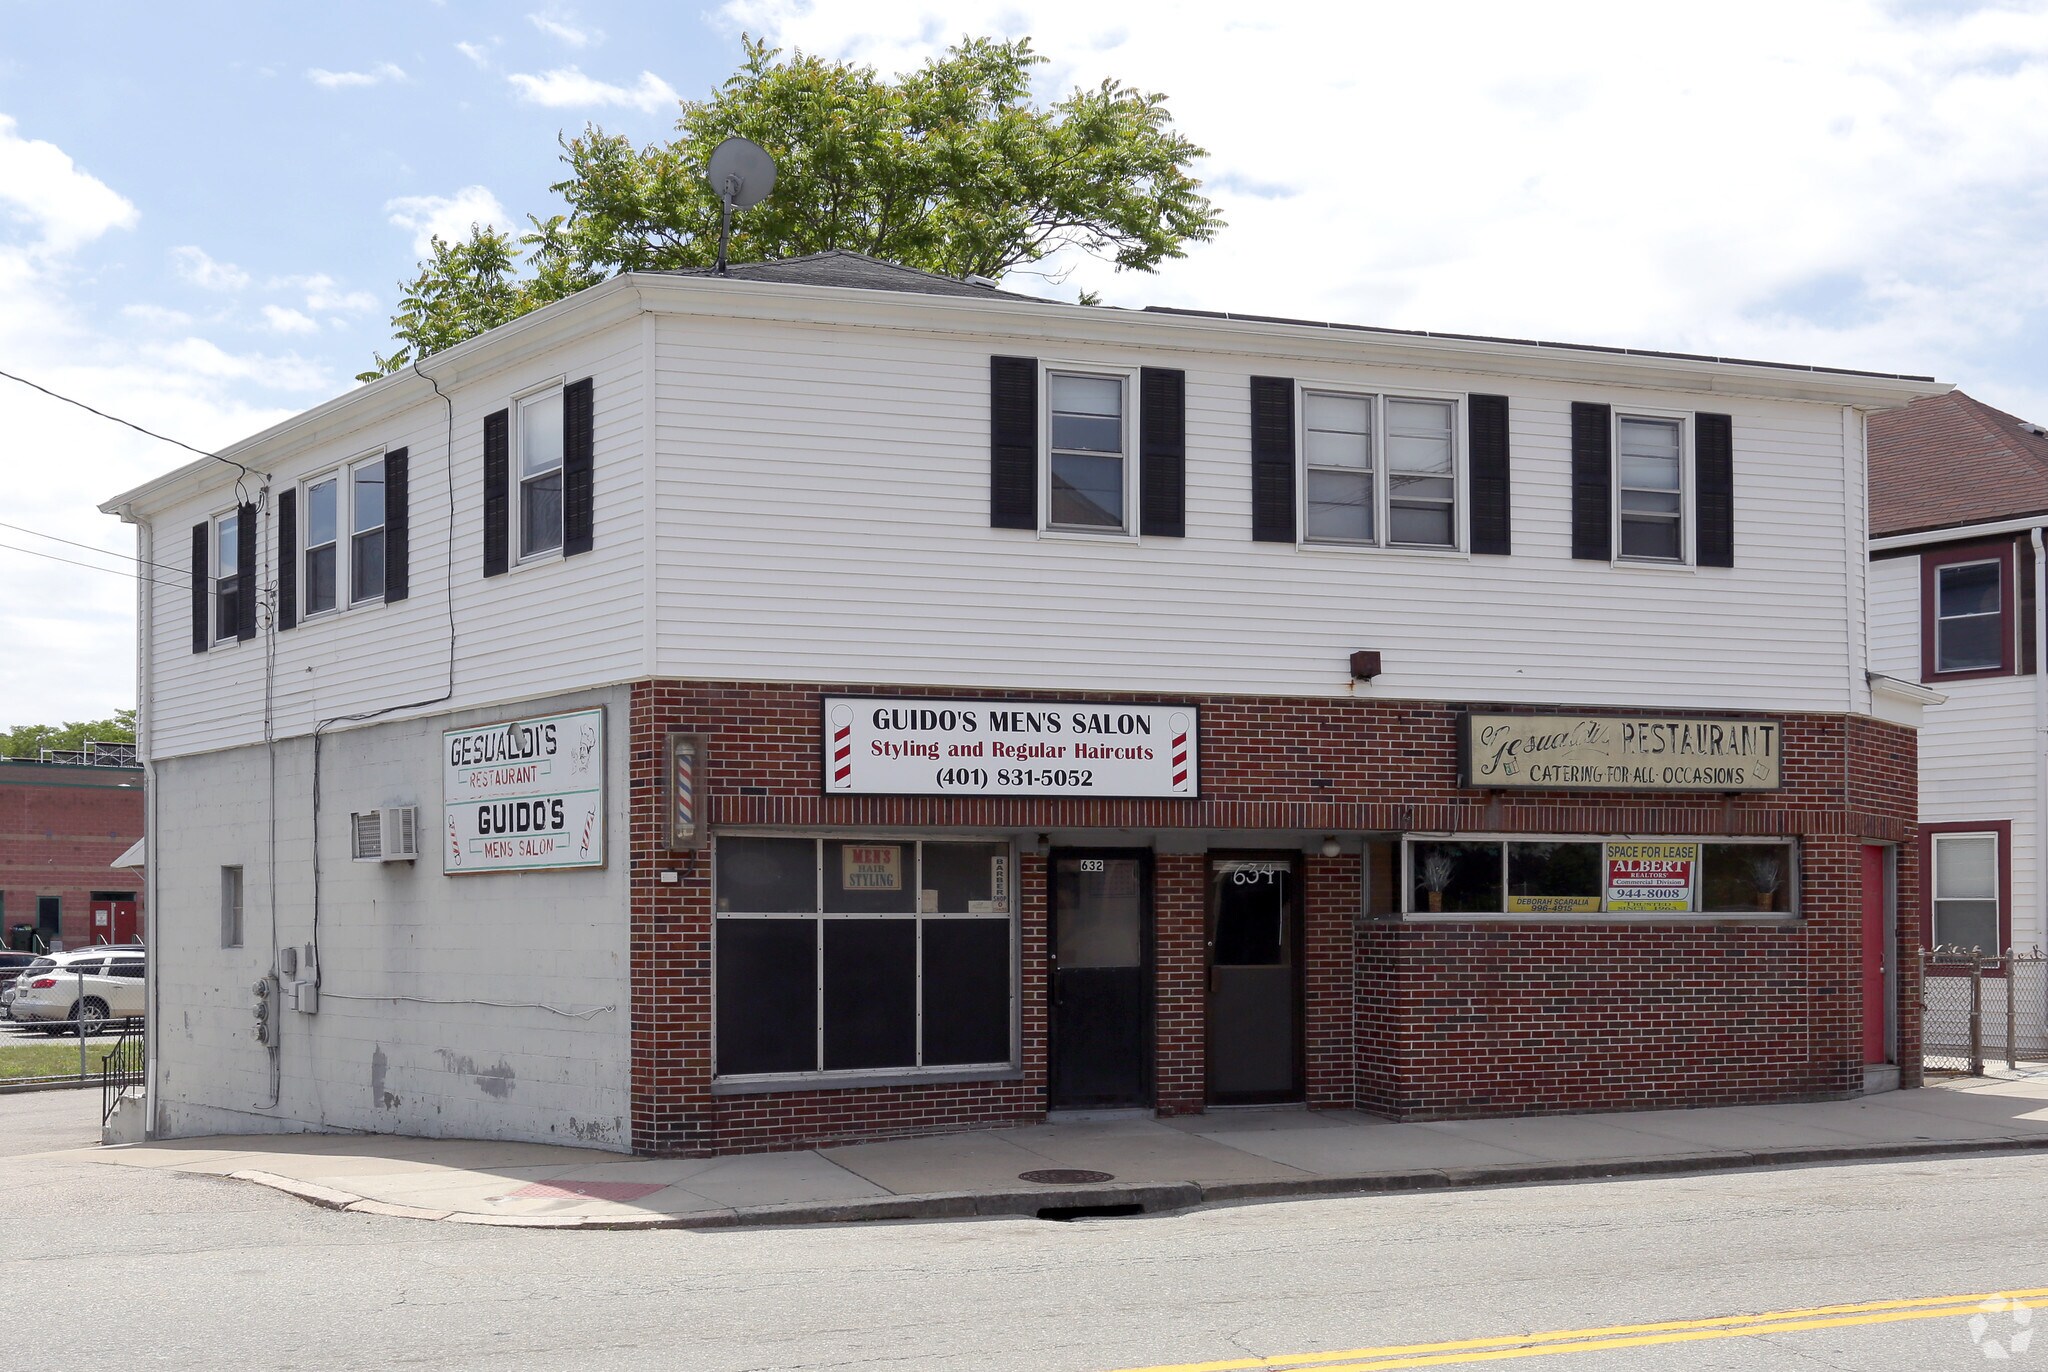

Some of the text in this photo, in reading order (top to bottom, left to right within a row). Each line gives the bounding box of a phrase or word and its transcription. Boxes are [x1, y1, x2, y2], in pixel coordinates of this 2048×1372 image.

[872, 708, 1151, 735] GUIDO'S MEN'S SALON
[451, 724, 557, 766] GESUALDI'S
[871, 739, 1154, 761] Styling and Regular Haircuts
[1622, 722, 1774, 757] RESTAURANT
[470, 765, 537, 788] RESTAURANT
[935, 767, 1093, 790] (401) 831-5052
[1530, 764, 1745, 784] CATERING FOR ALL OCCASIONS
[478, 798, 564, 834] GUIDO'S
[485, 838, 554, 859] MENS SALON
[852, 848, 891, 864] MEN'S
[1608, 846, 1694, 858] SPACE FOR LEASE
[858, 864, 885, 872] HAIR
[1081, 861, 1103, 871] 632
[1233, 863, 1274, 885] 634
[1614, 860, 1686, 872] ALBERT
[849, 873, 894, 887] STYLING
[996, 858, 1004, 896] BARBER
[1554, 898, 1589, 906] SCARALIA
[1617, 888, 1680, 898] 944-8008
